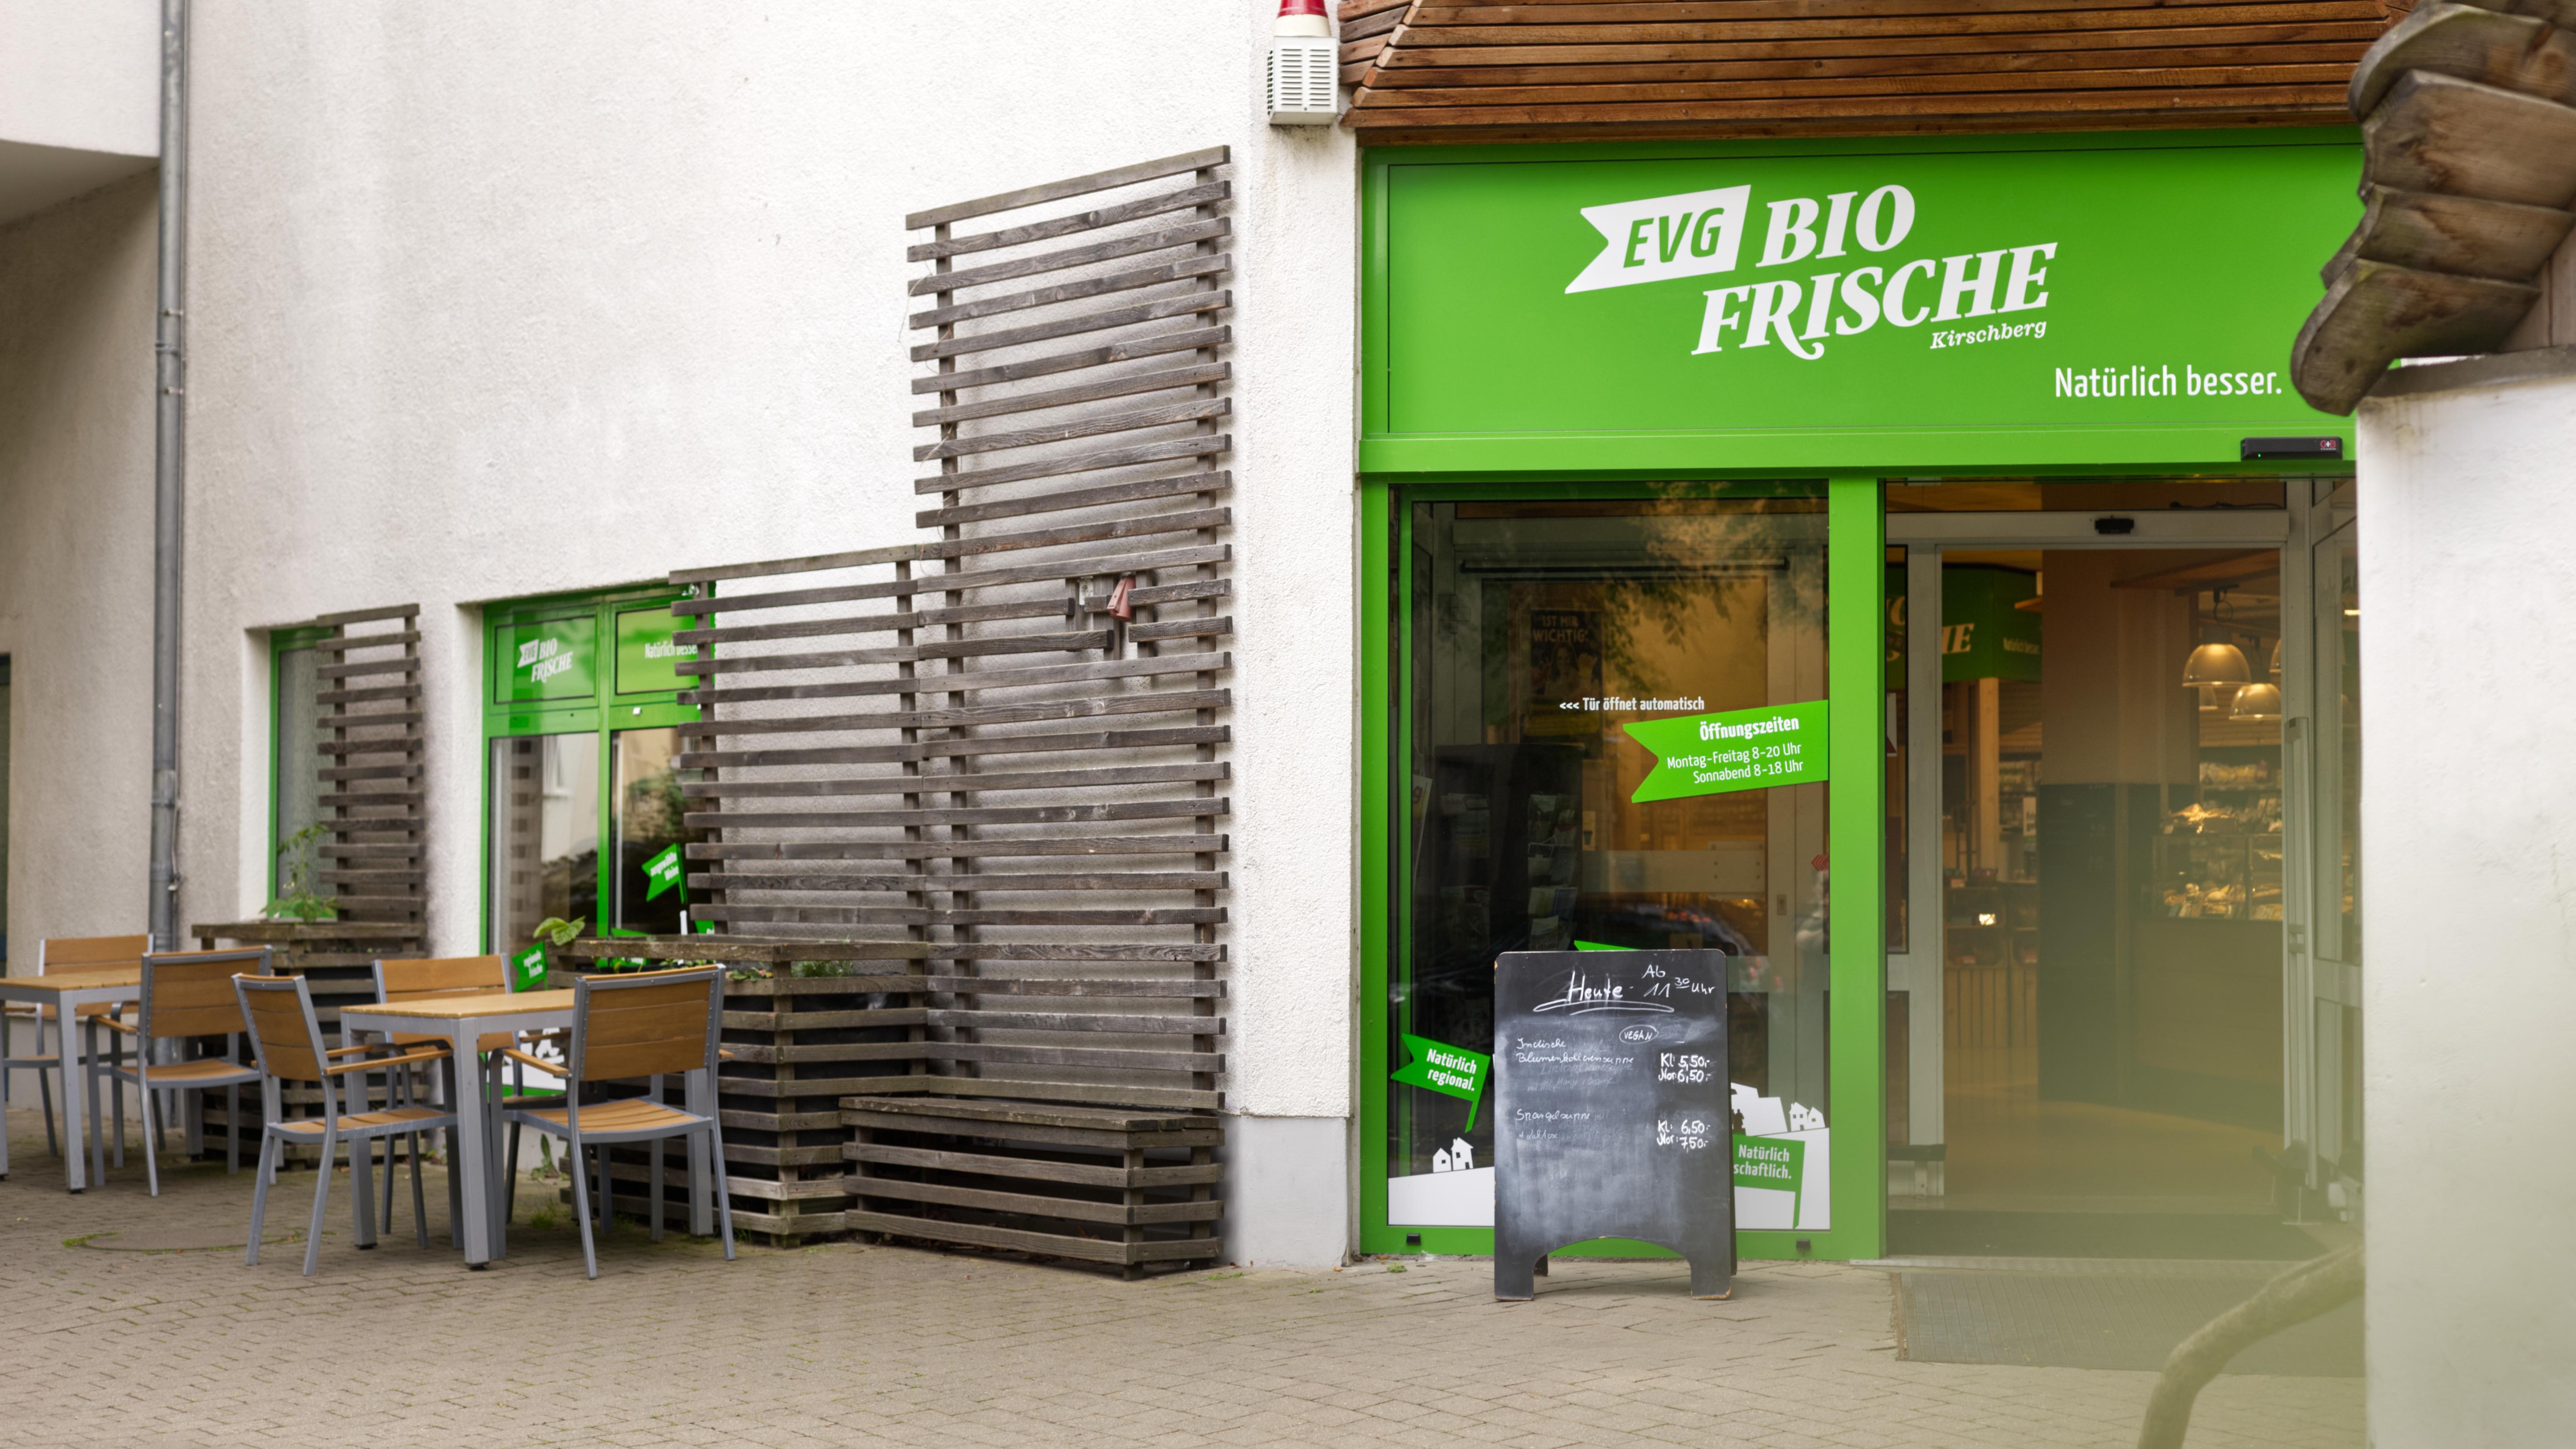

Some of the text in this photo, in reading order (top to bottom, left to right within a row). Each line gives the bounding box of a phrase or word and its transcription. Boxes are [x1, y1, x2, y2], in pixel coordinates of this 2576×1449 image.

[1623, 185, 1915, 269] EVG BIO
[1691, 241, 2057, 360] FRISCHE
[1929, 317, 2047, 349] Kirschberg
[2055, 363, 2282, 398] Natürlich besser.
[539, 637, 557, 660] BIO
[645, 640, 675, 659] Natürlich
[531, 651, 574, 683] FRISCHE
[1583, 697, 1704, 711] Tür öffnet automatisch
[1699, 716, 1799, 741] Öffnungszeiten
[1667, 743, 1801, 770] Montag-Freitag 8-20 Uhr
[1693, 760, 1803, 784] Sonnabend 8-18 Uhr
[1642, 964, 1666, 979] Ab
[1567, 971, 1623, 1004] Heute
[1691, 982, 1716, 995] Uhr
[1516, 1038, 1566, 1049] Indische
[1625, 1030, 1652, 1041] VEGAN
[1426, 1049, 1477, 1074] Natürlich
[1428, 1069, 1475, 1091] regional.
[1739, 1144, 1790, 1162] Natürlich
